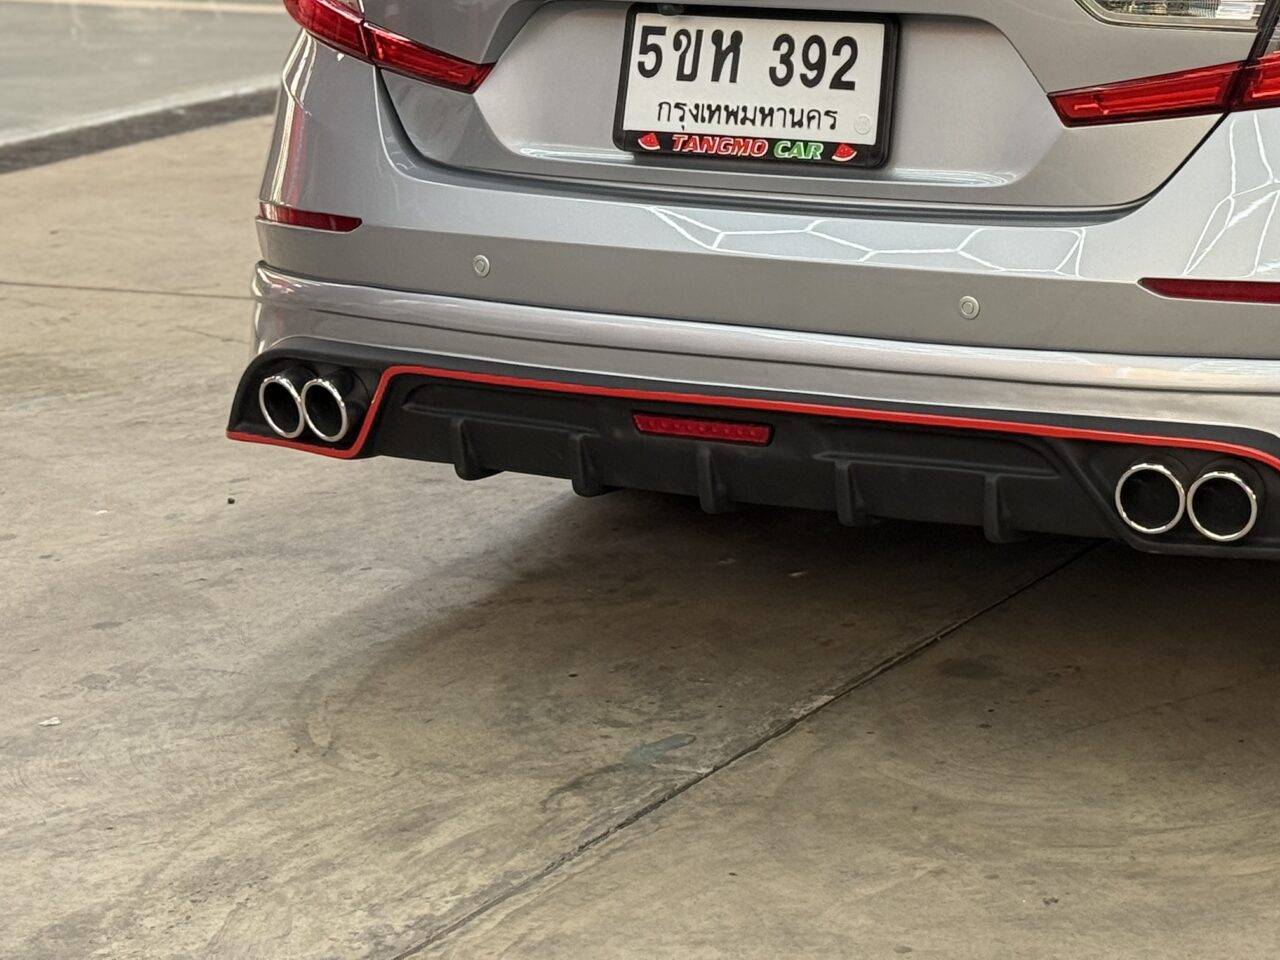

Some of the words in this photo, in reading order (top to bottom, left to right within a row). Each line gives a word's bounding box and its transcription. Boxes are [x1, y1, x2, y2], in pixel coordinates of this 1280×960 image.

[637, 24, 744, 84] 5ขห
[768, 33, 859, 92] 392
[656, 100, 839, 132] กรุงเทพมหานคร
[671, 133, 769, 158] TANGMO
[772, 140, 824, 161] CAR
